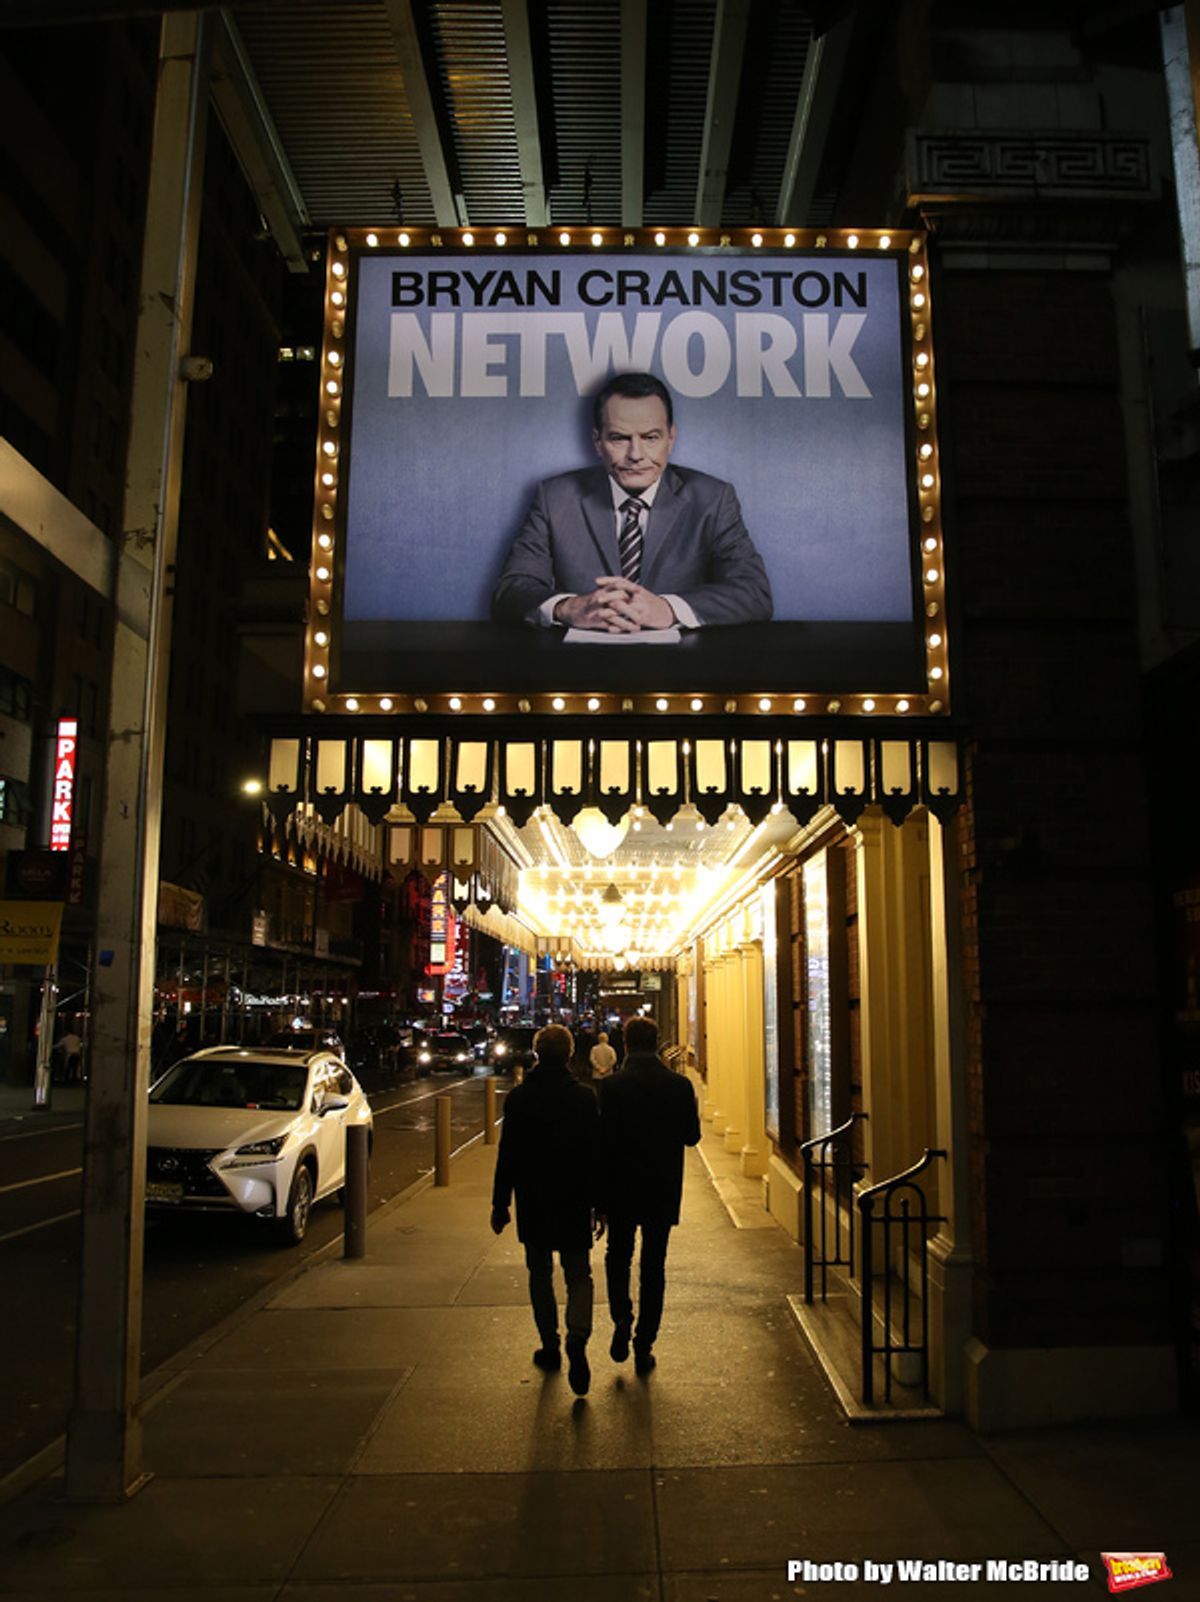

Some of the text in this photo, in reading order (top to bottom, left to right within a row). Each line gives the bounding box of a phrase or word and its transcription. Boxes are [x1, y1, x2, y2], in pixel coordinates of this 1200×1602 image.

[391, 268, 868, 308] BRYAN CRANSTON
[387, 311, 873, 399] NETWORK
[53, 738, 76, 821] PARK
